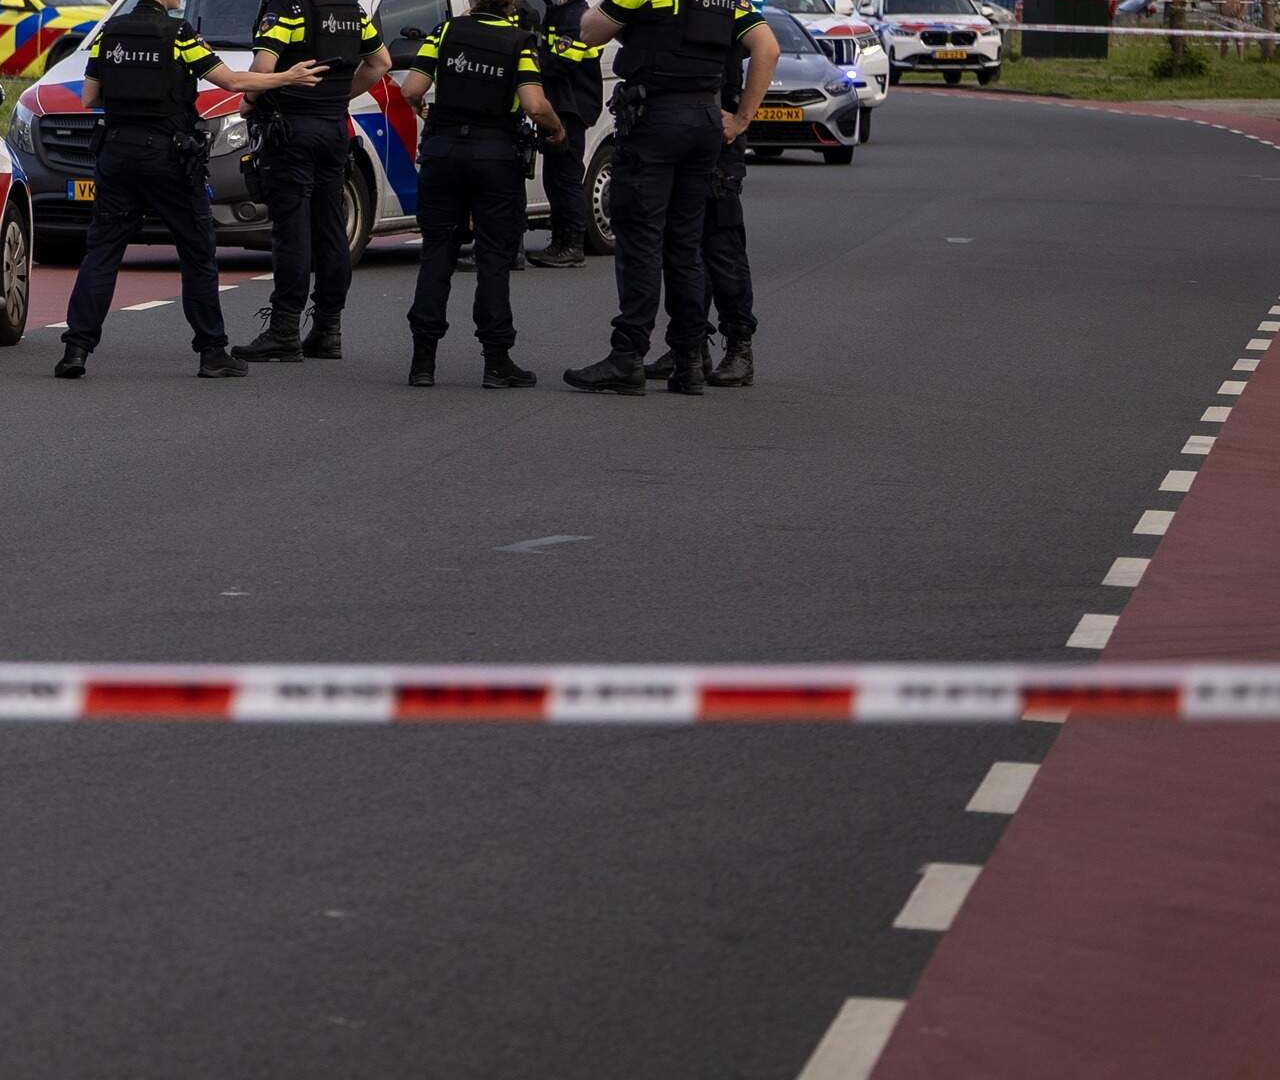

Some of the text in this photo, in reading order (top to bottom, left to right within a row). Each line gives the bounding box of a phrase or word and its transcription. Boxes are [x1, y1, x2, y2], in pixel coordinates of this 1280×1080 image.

[322, 15, 360, 32] POLITIE
[106, 45, 160, 63] POLITIE
[447, 54, 505, 77] POLITIE
